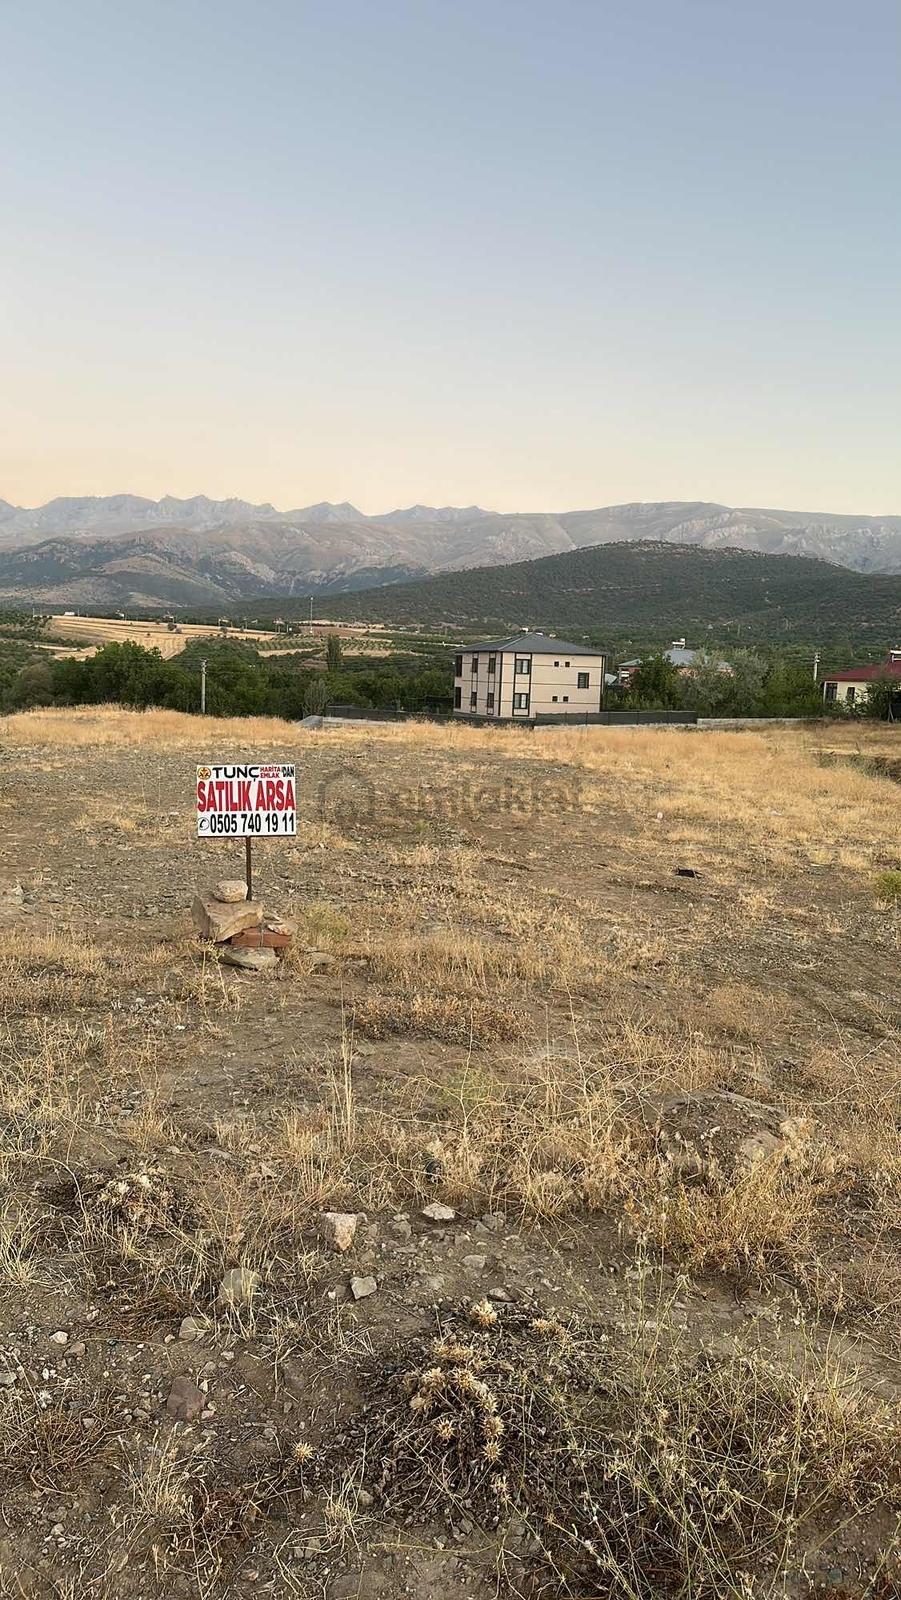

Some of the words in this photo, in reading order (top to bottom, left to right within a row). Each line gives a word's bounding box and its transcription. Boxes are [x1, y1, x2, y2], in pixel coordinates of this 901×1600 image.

[212, 766, 260, 782] TUNÇ
[197, 780, 252, 812] SATILIK
[255, 780, 296, 811] ARSA
[210, 813, 237, 833] 0505
[241, 813, 261, 832] 740
[265, 812, 278, 832] 19
[282, 812, 294, 832] 11
